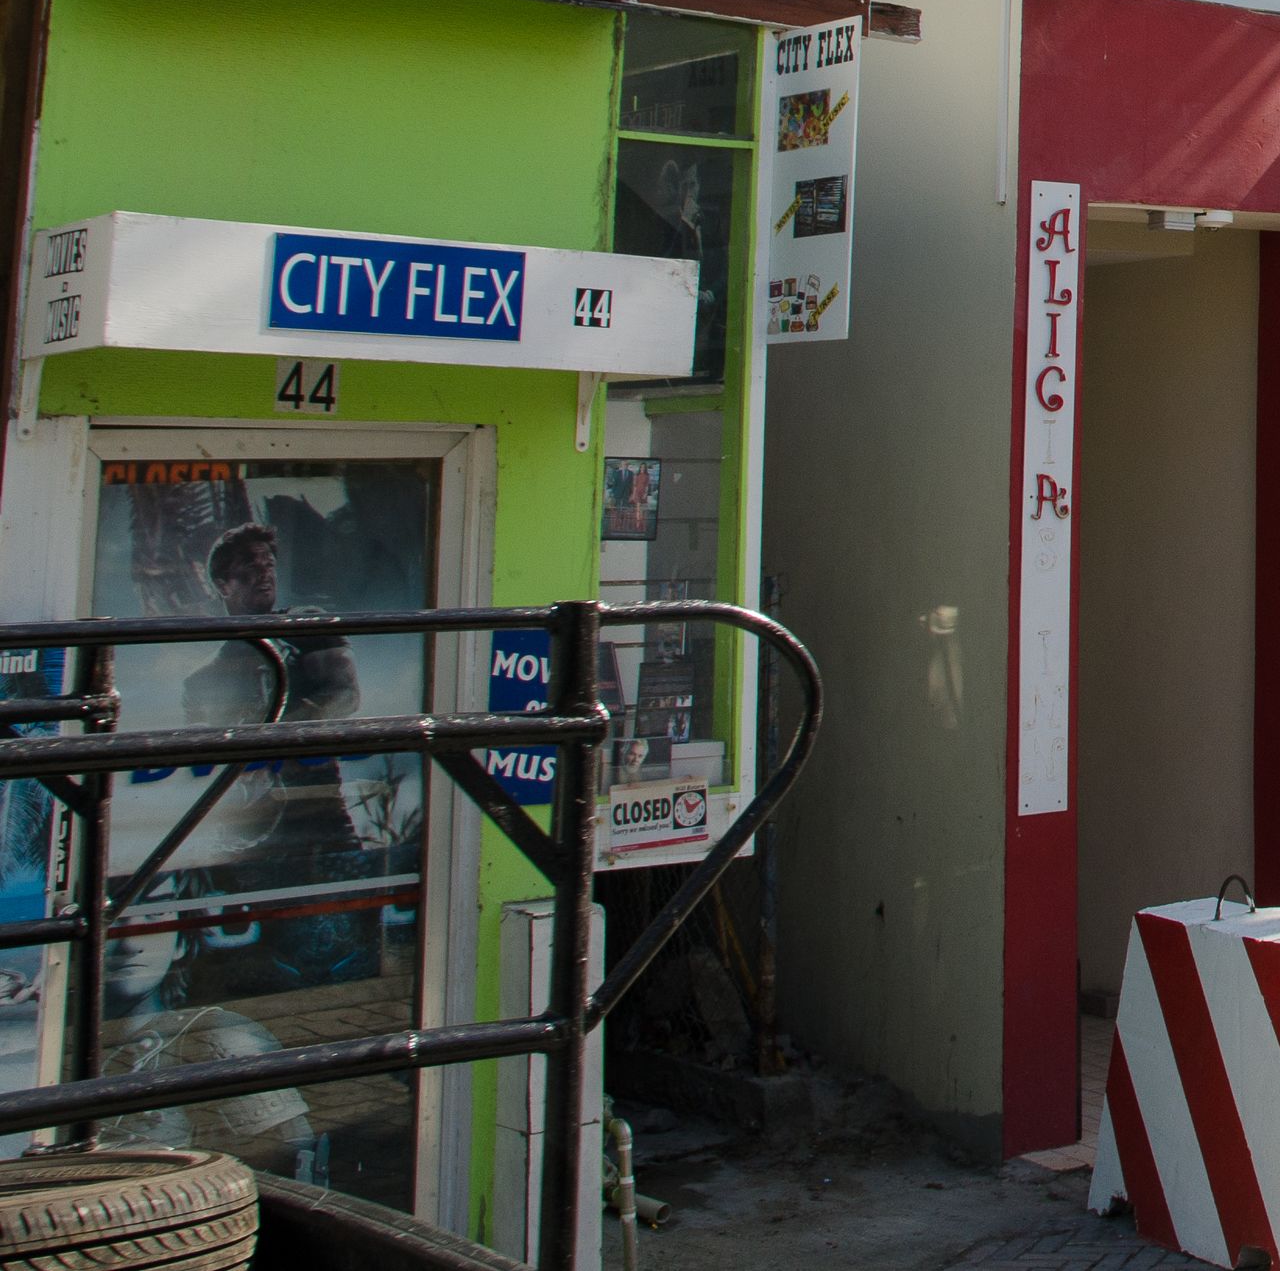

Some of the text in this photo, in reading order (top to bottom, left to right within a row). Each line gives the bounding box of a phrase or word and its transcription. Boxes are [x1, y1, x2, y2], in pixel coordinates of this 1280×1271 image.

[777, 24, 856, 76] CITY FLEX
[44, 228, 88, 278] MOVIES
[279, 251, 521, 329] CITY FLEX
[575, 287, 613, 328] 44
[44, 294, 82, 345] MUSIC
[277, 360, 338, 413] 44
[0, 650, 38, 675] ind
[491, 649, 551, 685] MOV
[486, 749, 558, 783] MUS
[612, 797, 672, 826] CLOSED
